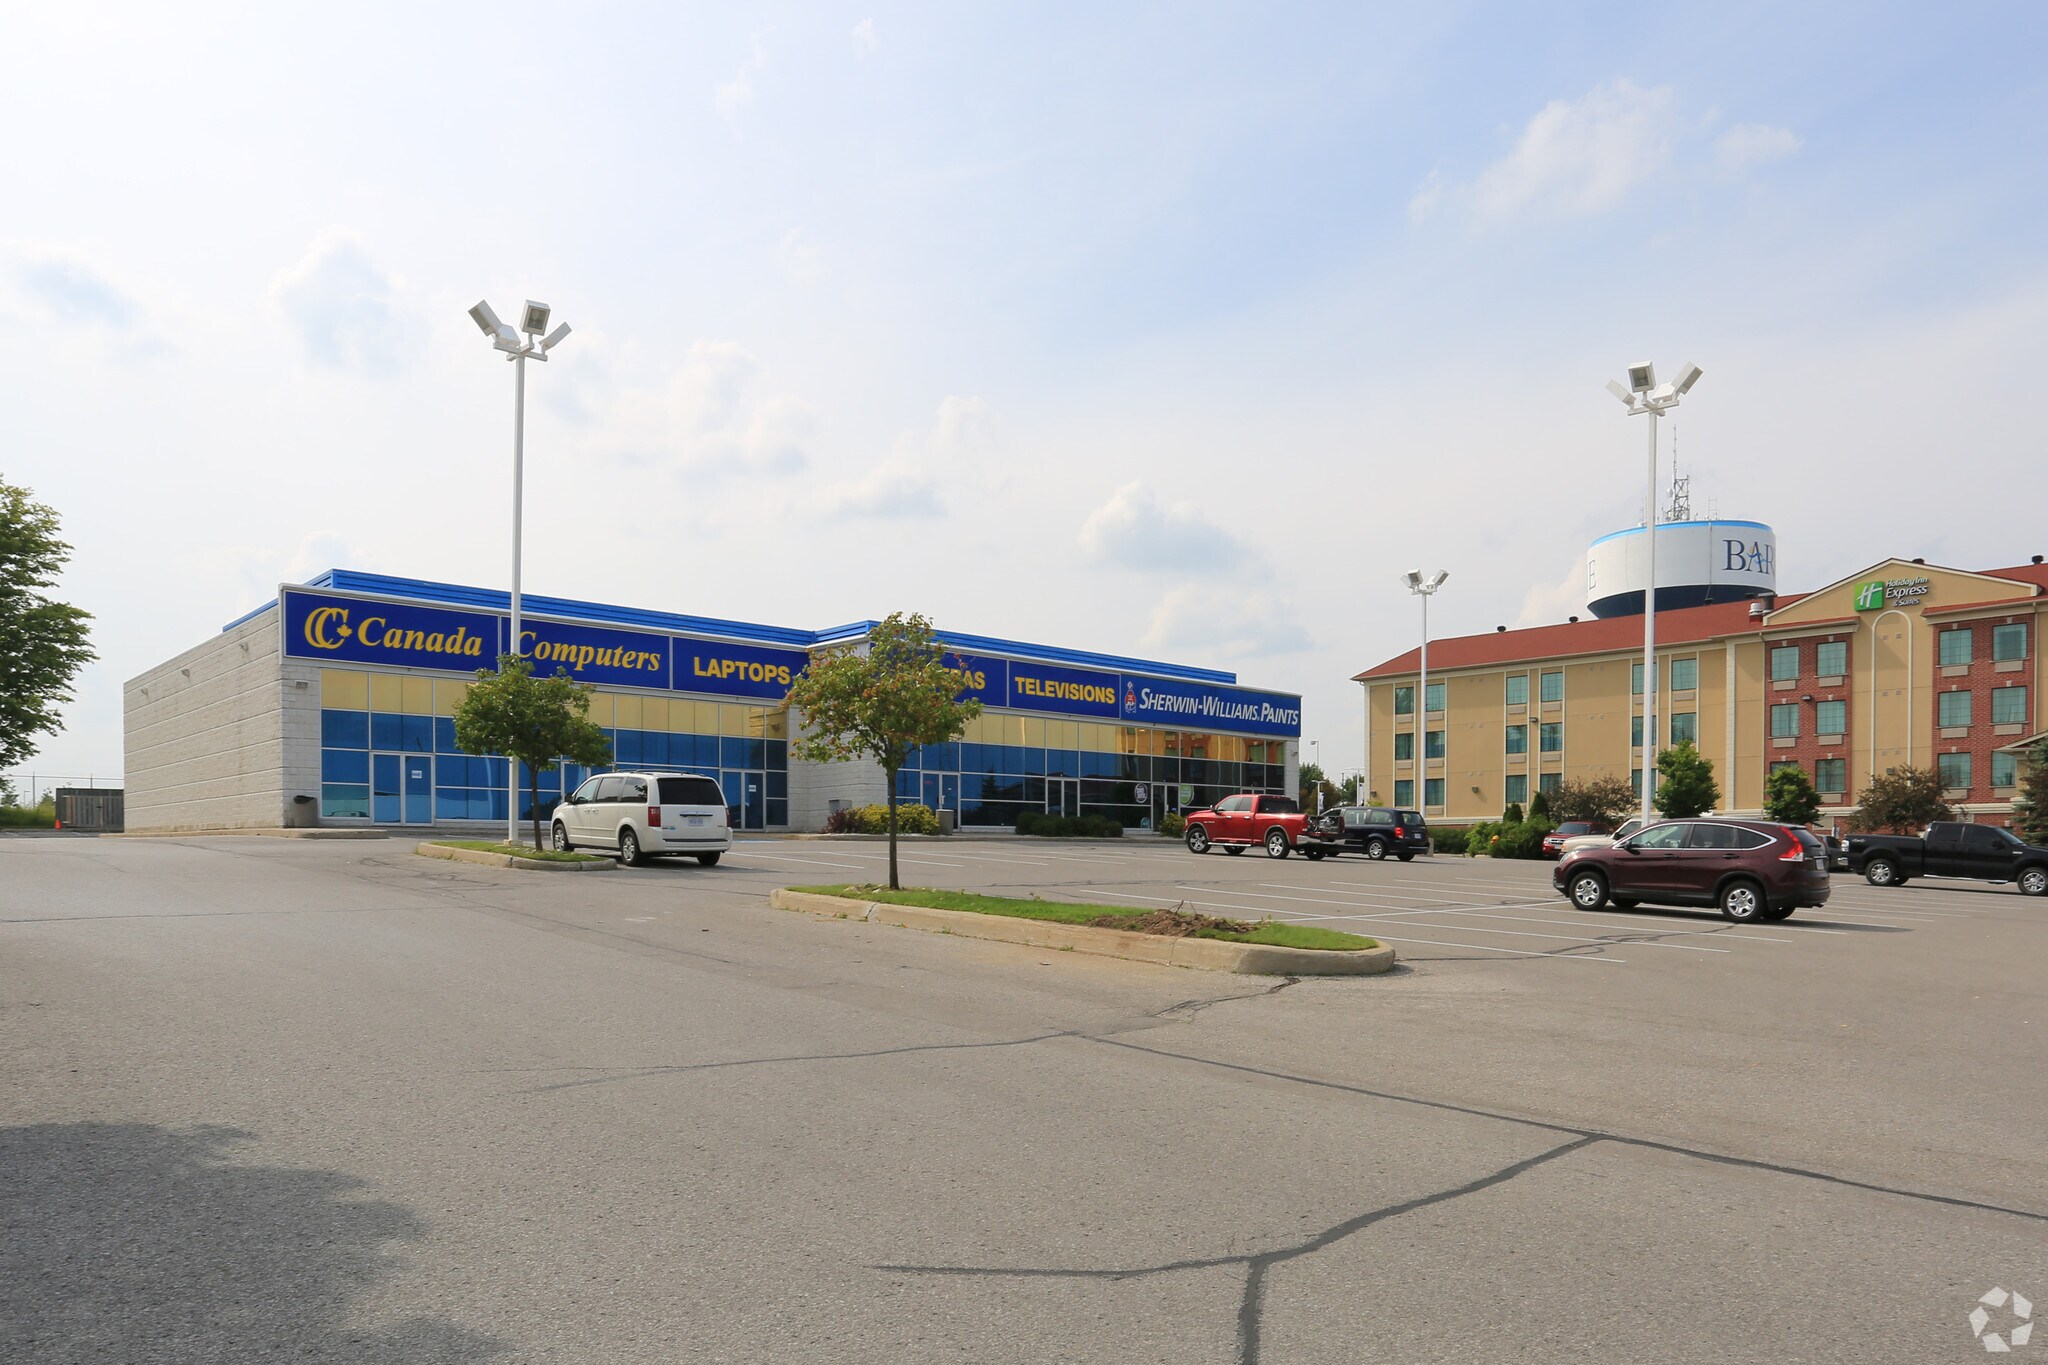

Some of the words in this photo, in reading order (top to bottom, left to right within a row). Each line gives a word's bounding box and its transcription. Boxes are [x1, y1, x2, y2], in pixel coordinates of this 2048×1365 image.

[1885, 585, 1928, 599] Express
[1886, 578, 1914, 589] Holiday
[1915, 576, 1928, 585] Inn
[1899, 598, 1920, 606] Suites
[357, 617, 483, 657] Canada
[517, 630, 661, 671] Computers
[694, 656, 791, 685] LAPTOPS
[1014, 676, 1116, 705] TELEVISIONS
[1260, 702, 1299, 726] PAINTS
